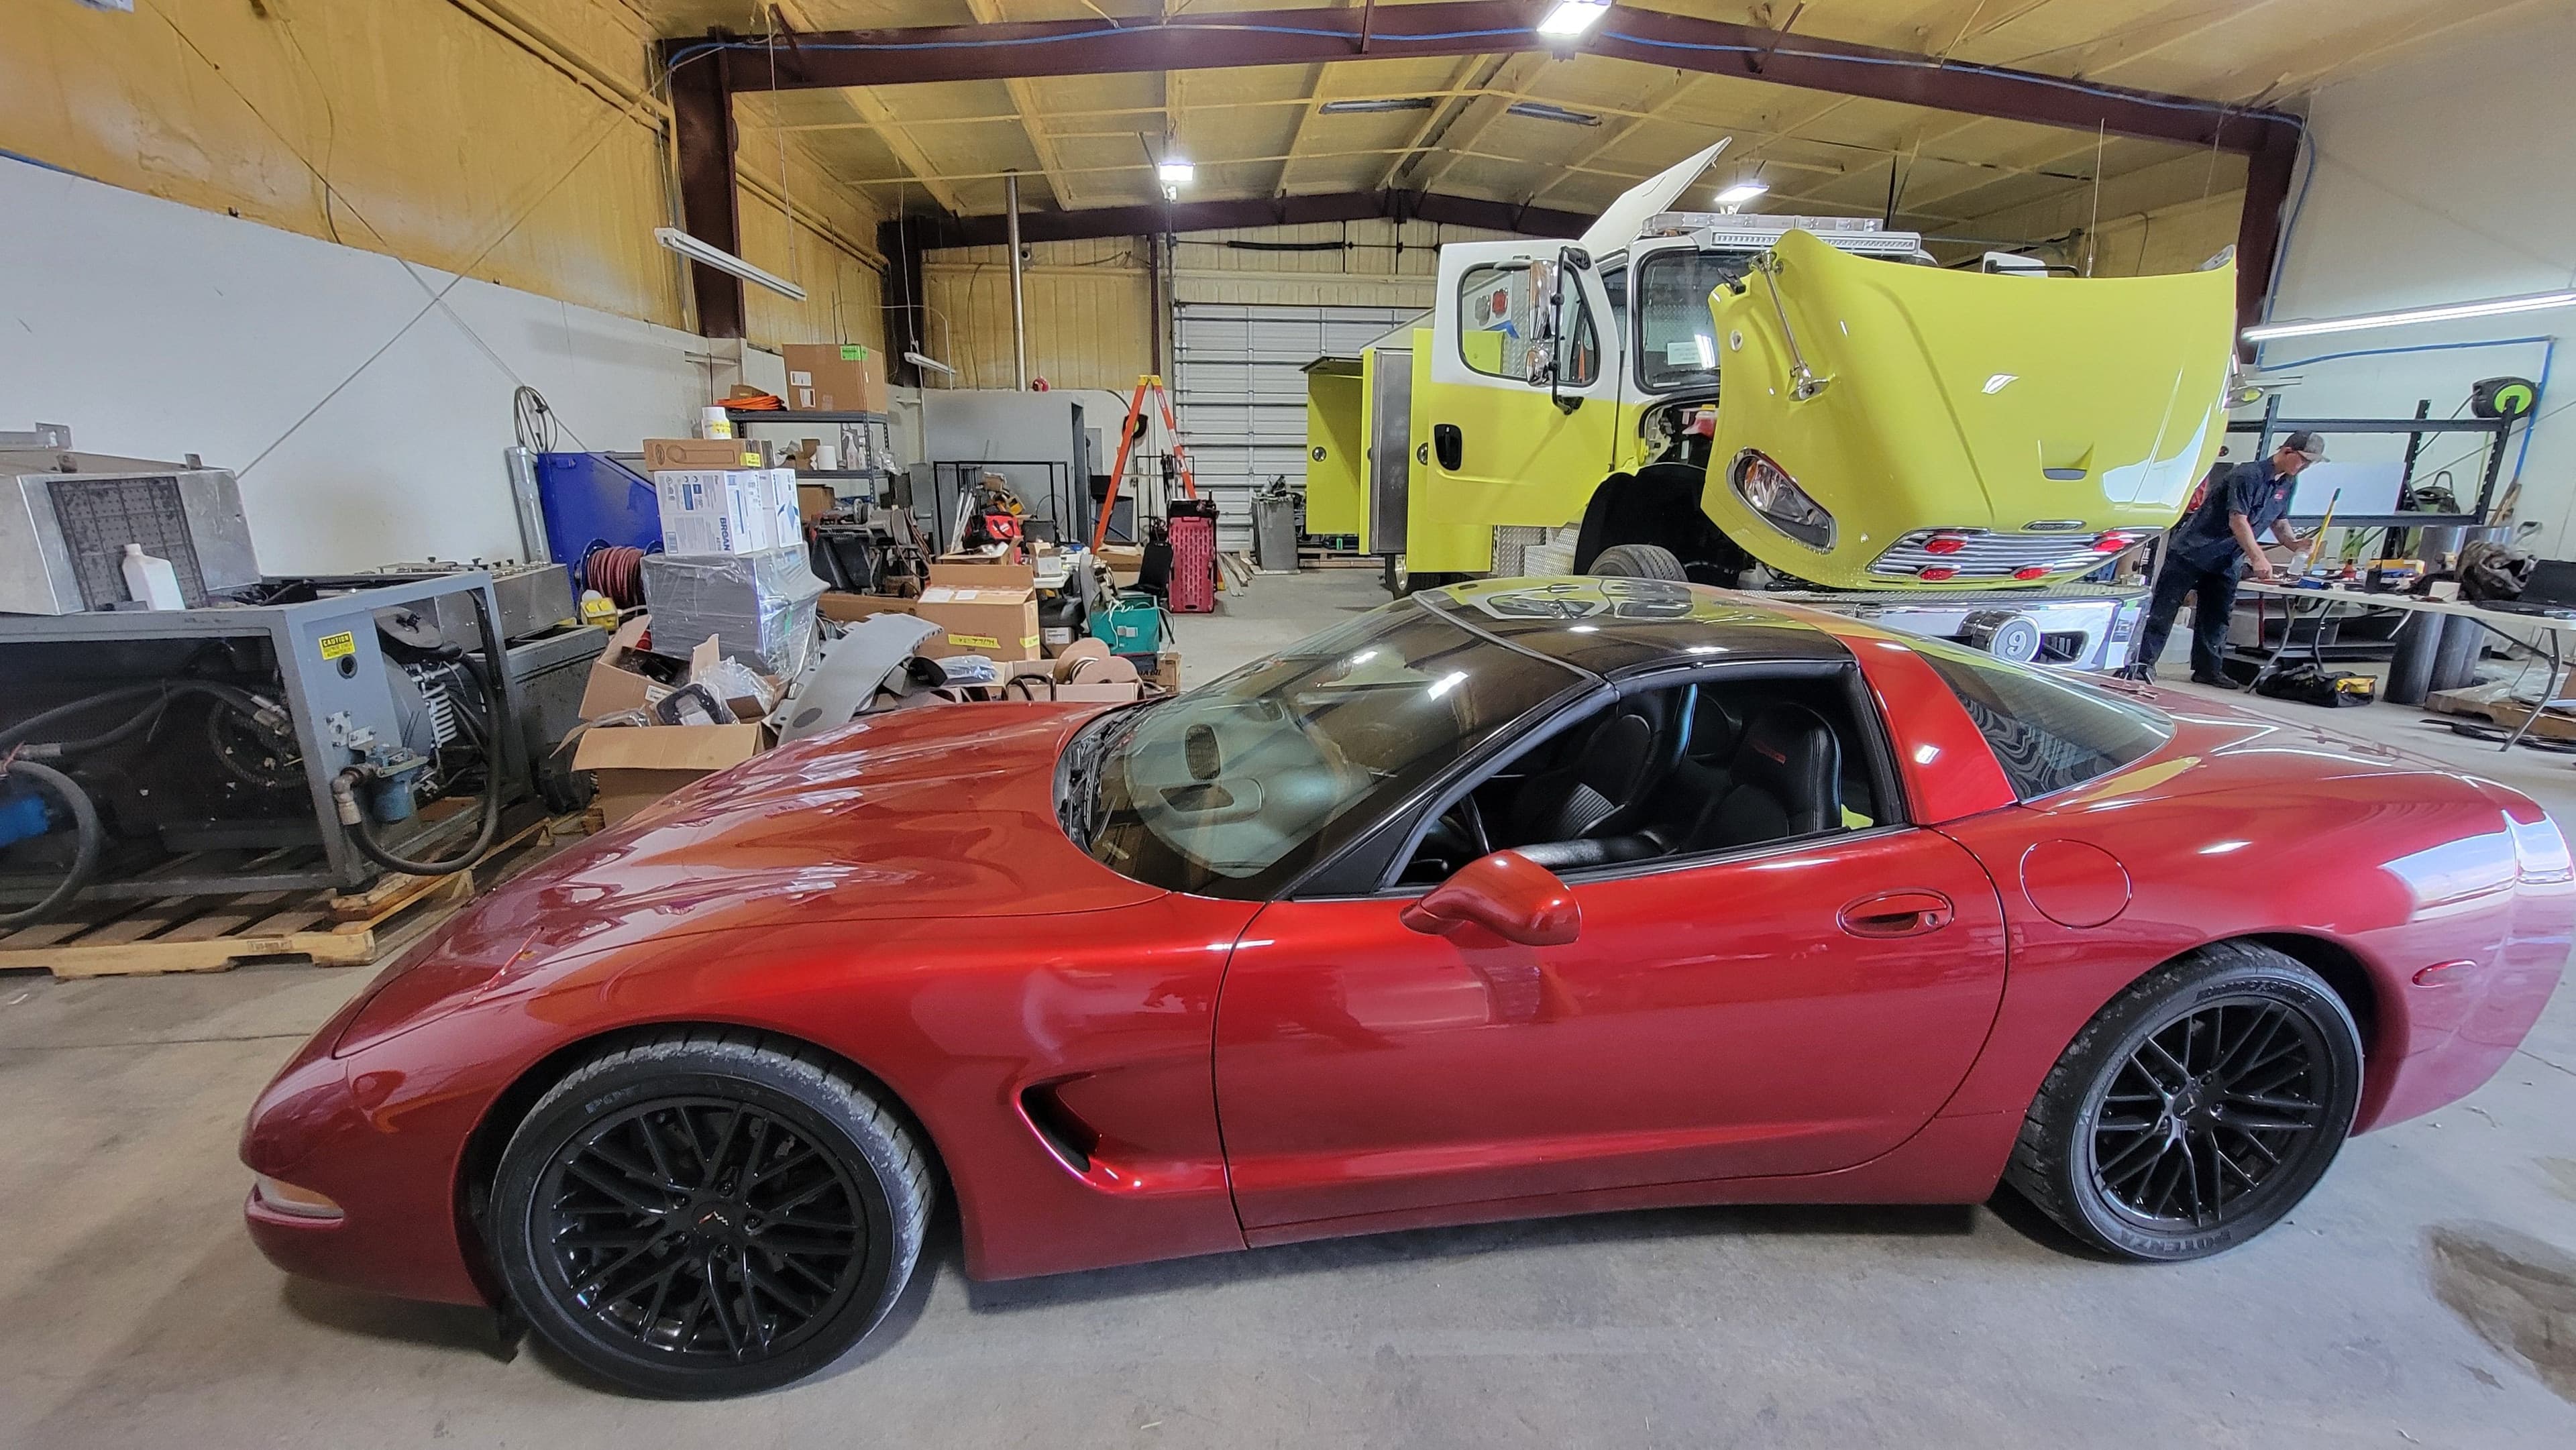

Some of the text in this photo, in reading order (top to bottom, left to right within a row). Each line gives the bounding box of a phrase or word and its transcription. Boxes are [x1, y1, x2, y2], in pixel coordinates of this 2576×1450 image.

[719, 517, 731, 551] BROAN
[323, 635, 349, 647] CAUTION
[2006, 630, 2027, 657] 9
